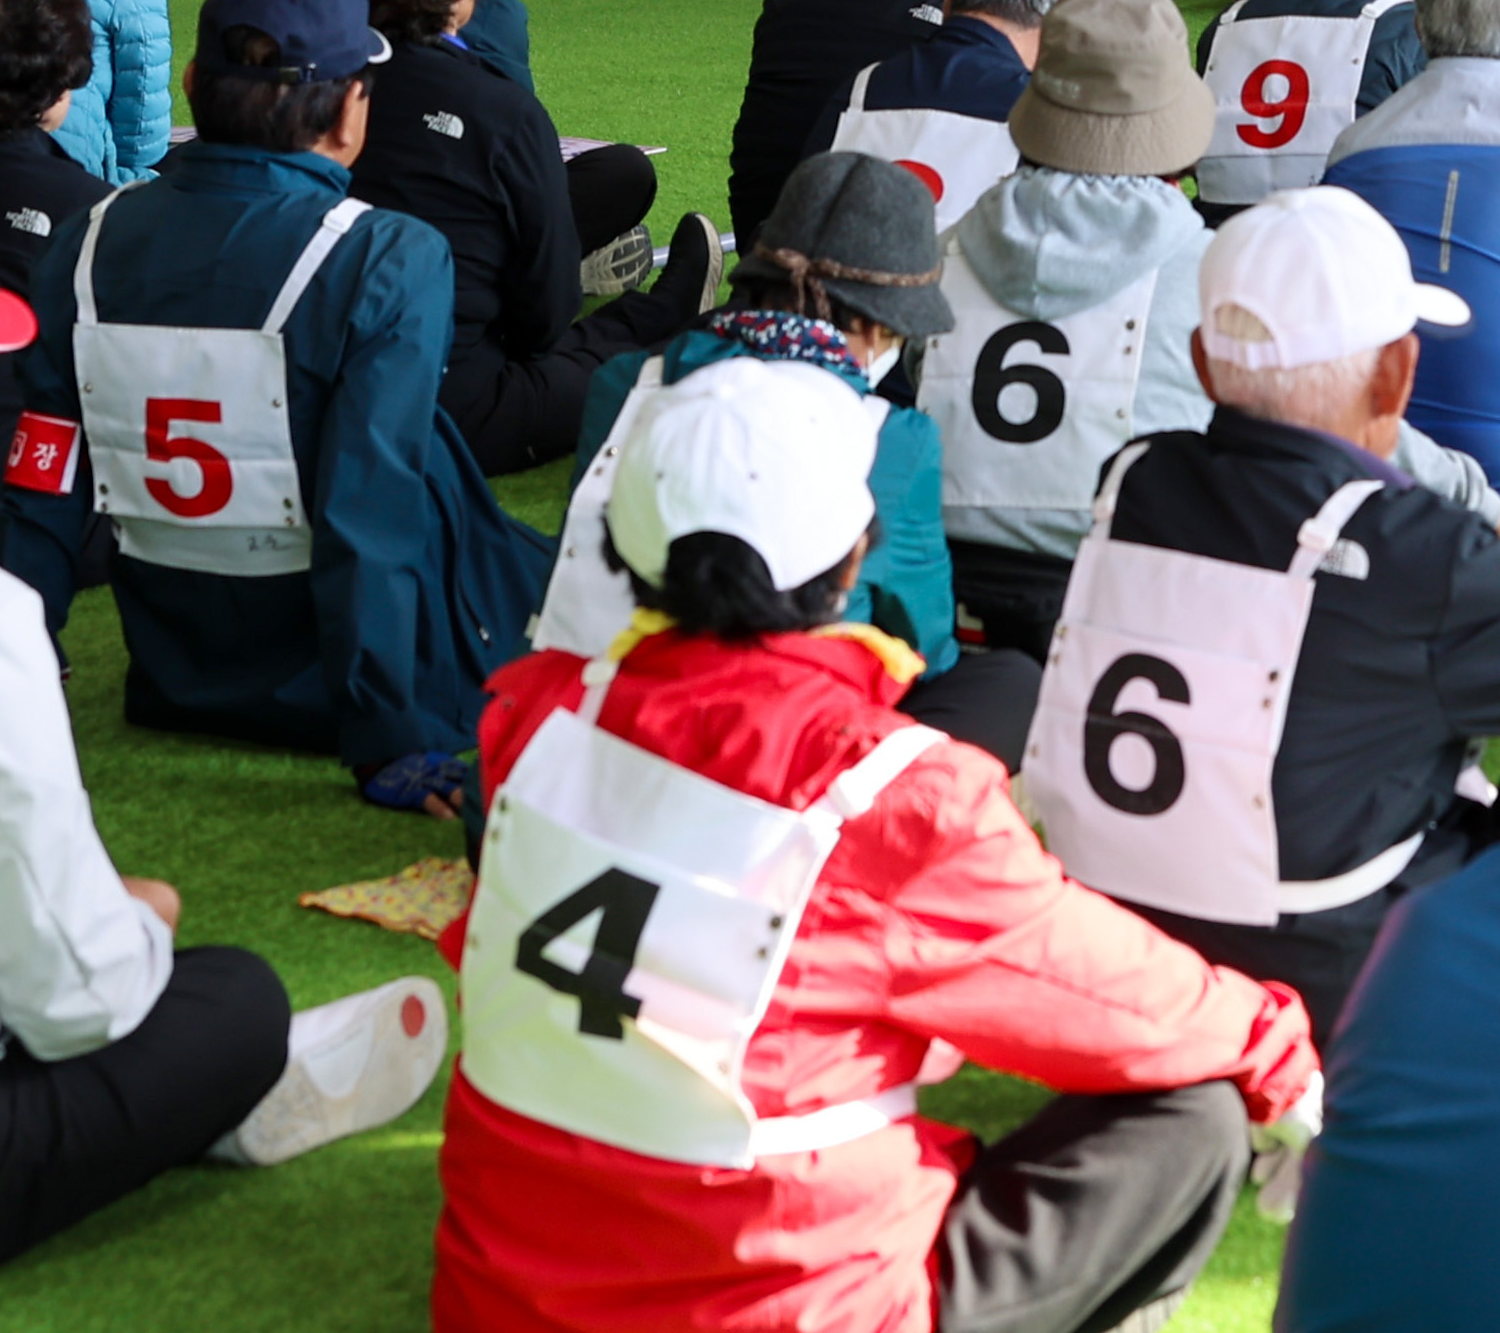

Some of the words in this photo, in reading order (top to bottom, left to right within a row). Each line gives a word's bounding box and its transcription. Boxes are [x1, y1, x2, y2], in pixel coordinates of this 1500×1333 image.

[1235, 59, 1310, 149] 9
[971, 321, 1070, 444] 6
[144, 398, 234, 518] 5
[1082, 652, 1191, 817] 6
[515, 866, 661, 1040] 4
